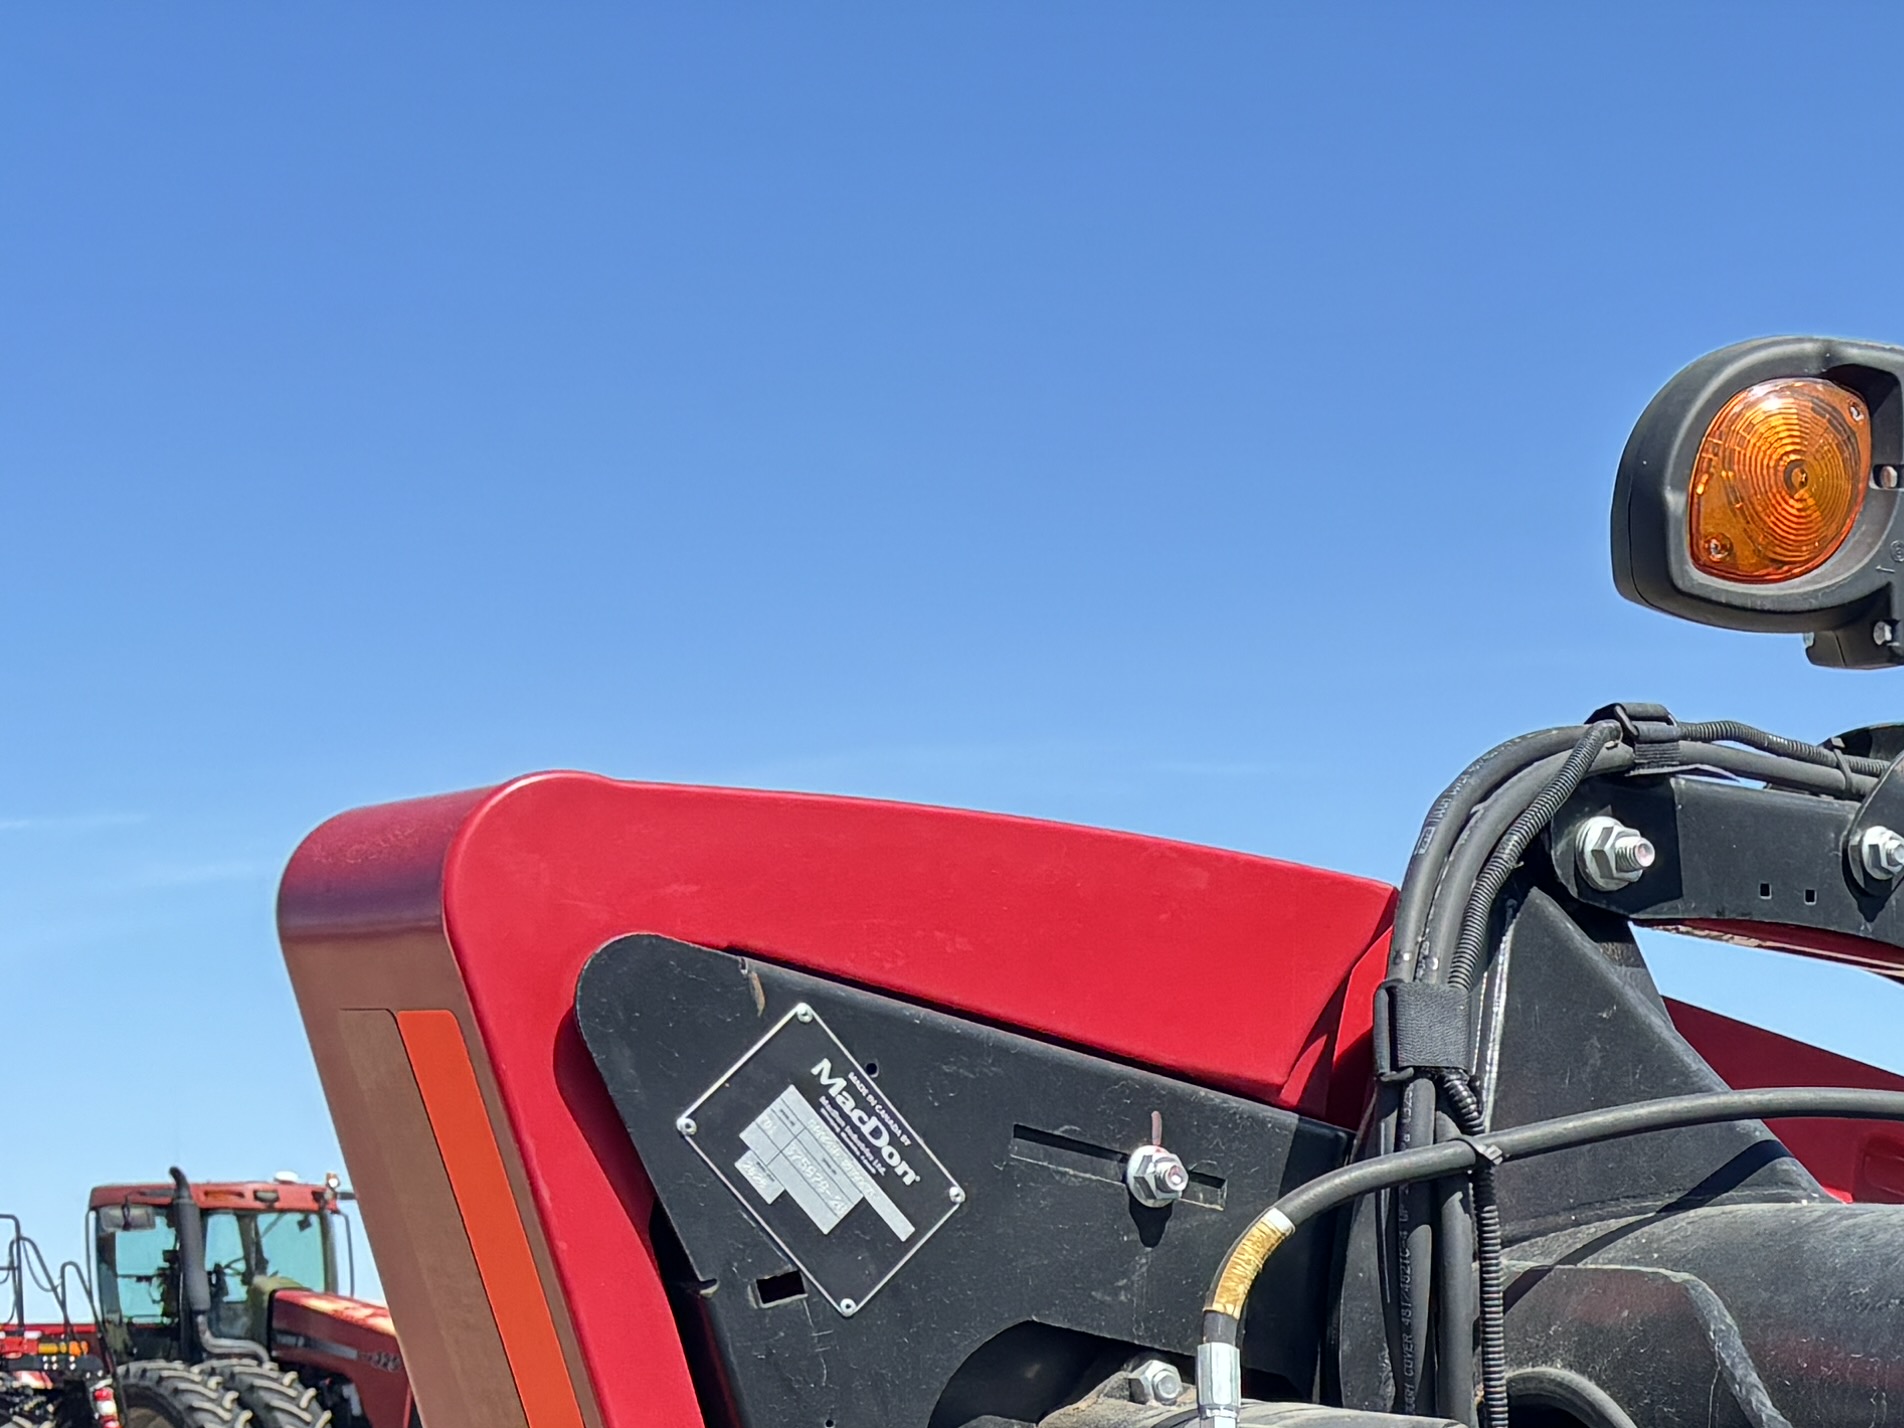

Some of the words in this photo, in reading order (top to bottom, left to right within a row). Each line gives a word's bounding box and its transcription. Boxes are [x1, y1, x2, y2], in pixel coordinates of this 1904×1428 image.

[846, 1071, 870, 1096] MADE
[865, 1093, 878, 1106] IN
[873, 1103, 903, 1136] CANADA
